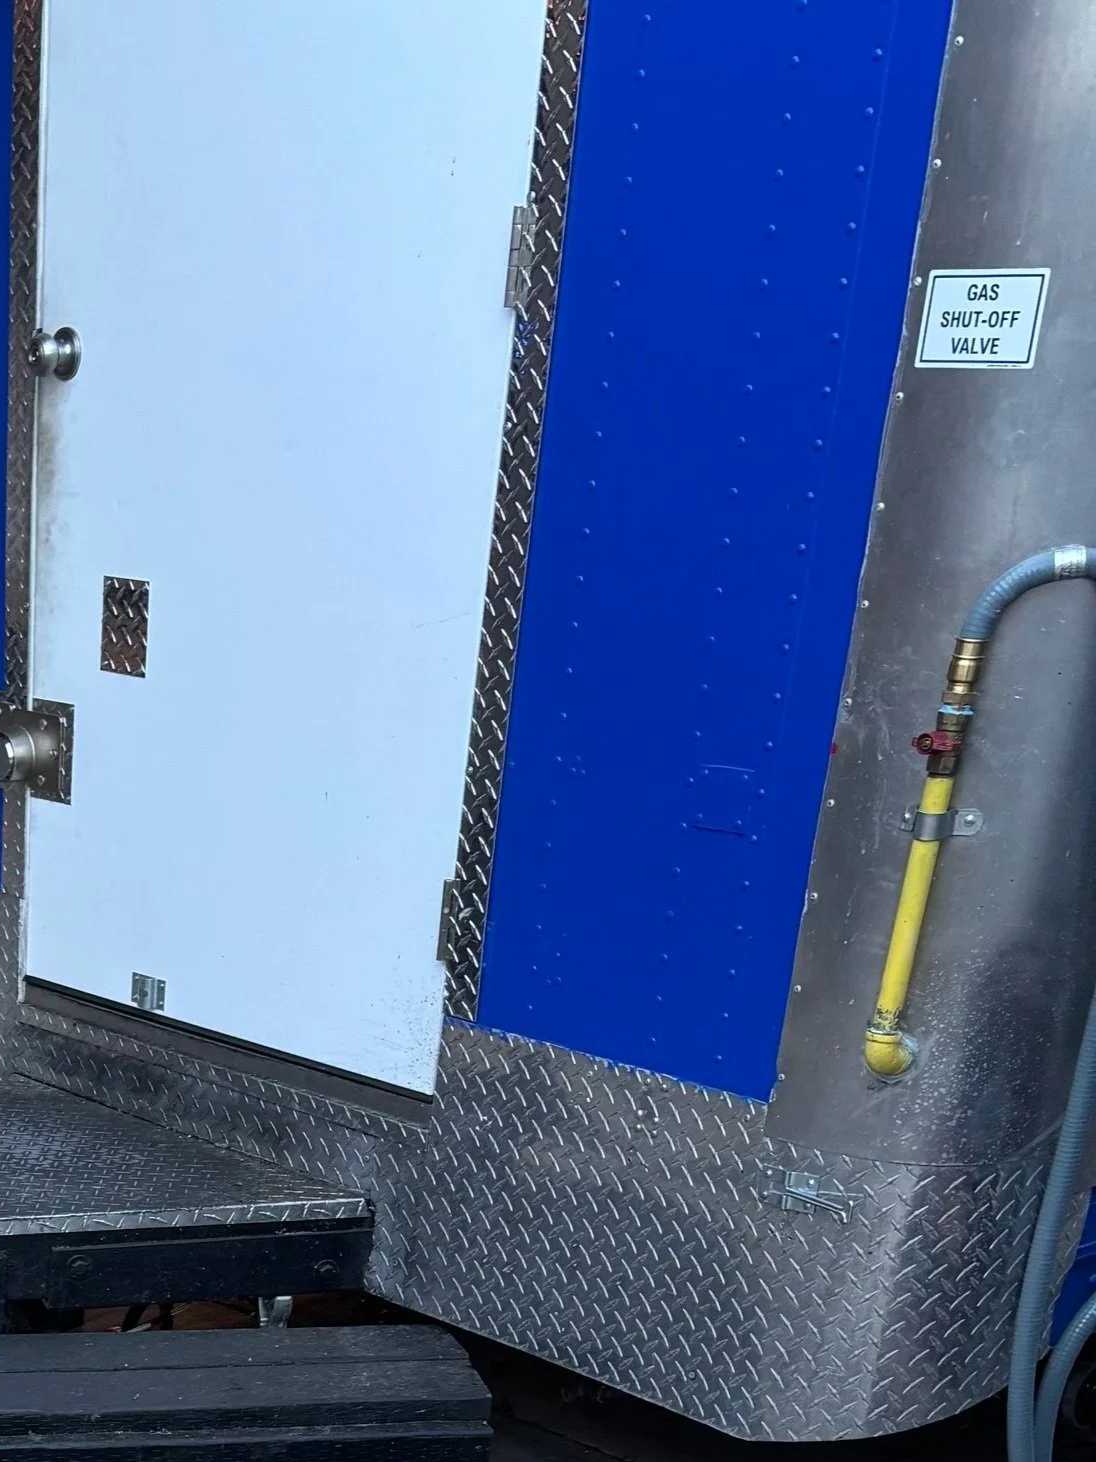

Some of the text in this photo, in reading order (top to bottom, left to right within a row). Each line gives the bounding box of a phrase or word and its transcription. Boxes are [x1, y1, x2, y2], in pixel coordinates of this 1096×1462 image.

[967, 283, 1000, 301] GAS
[940, 310, 1021, 328] SHUT-OFF
[951, 337, 1000, 354] VALVE
